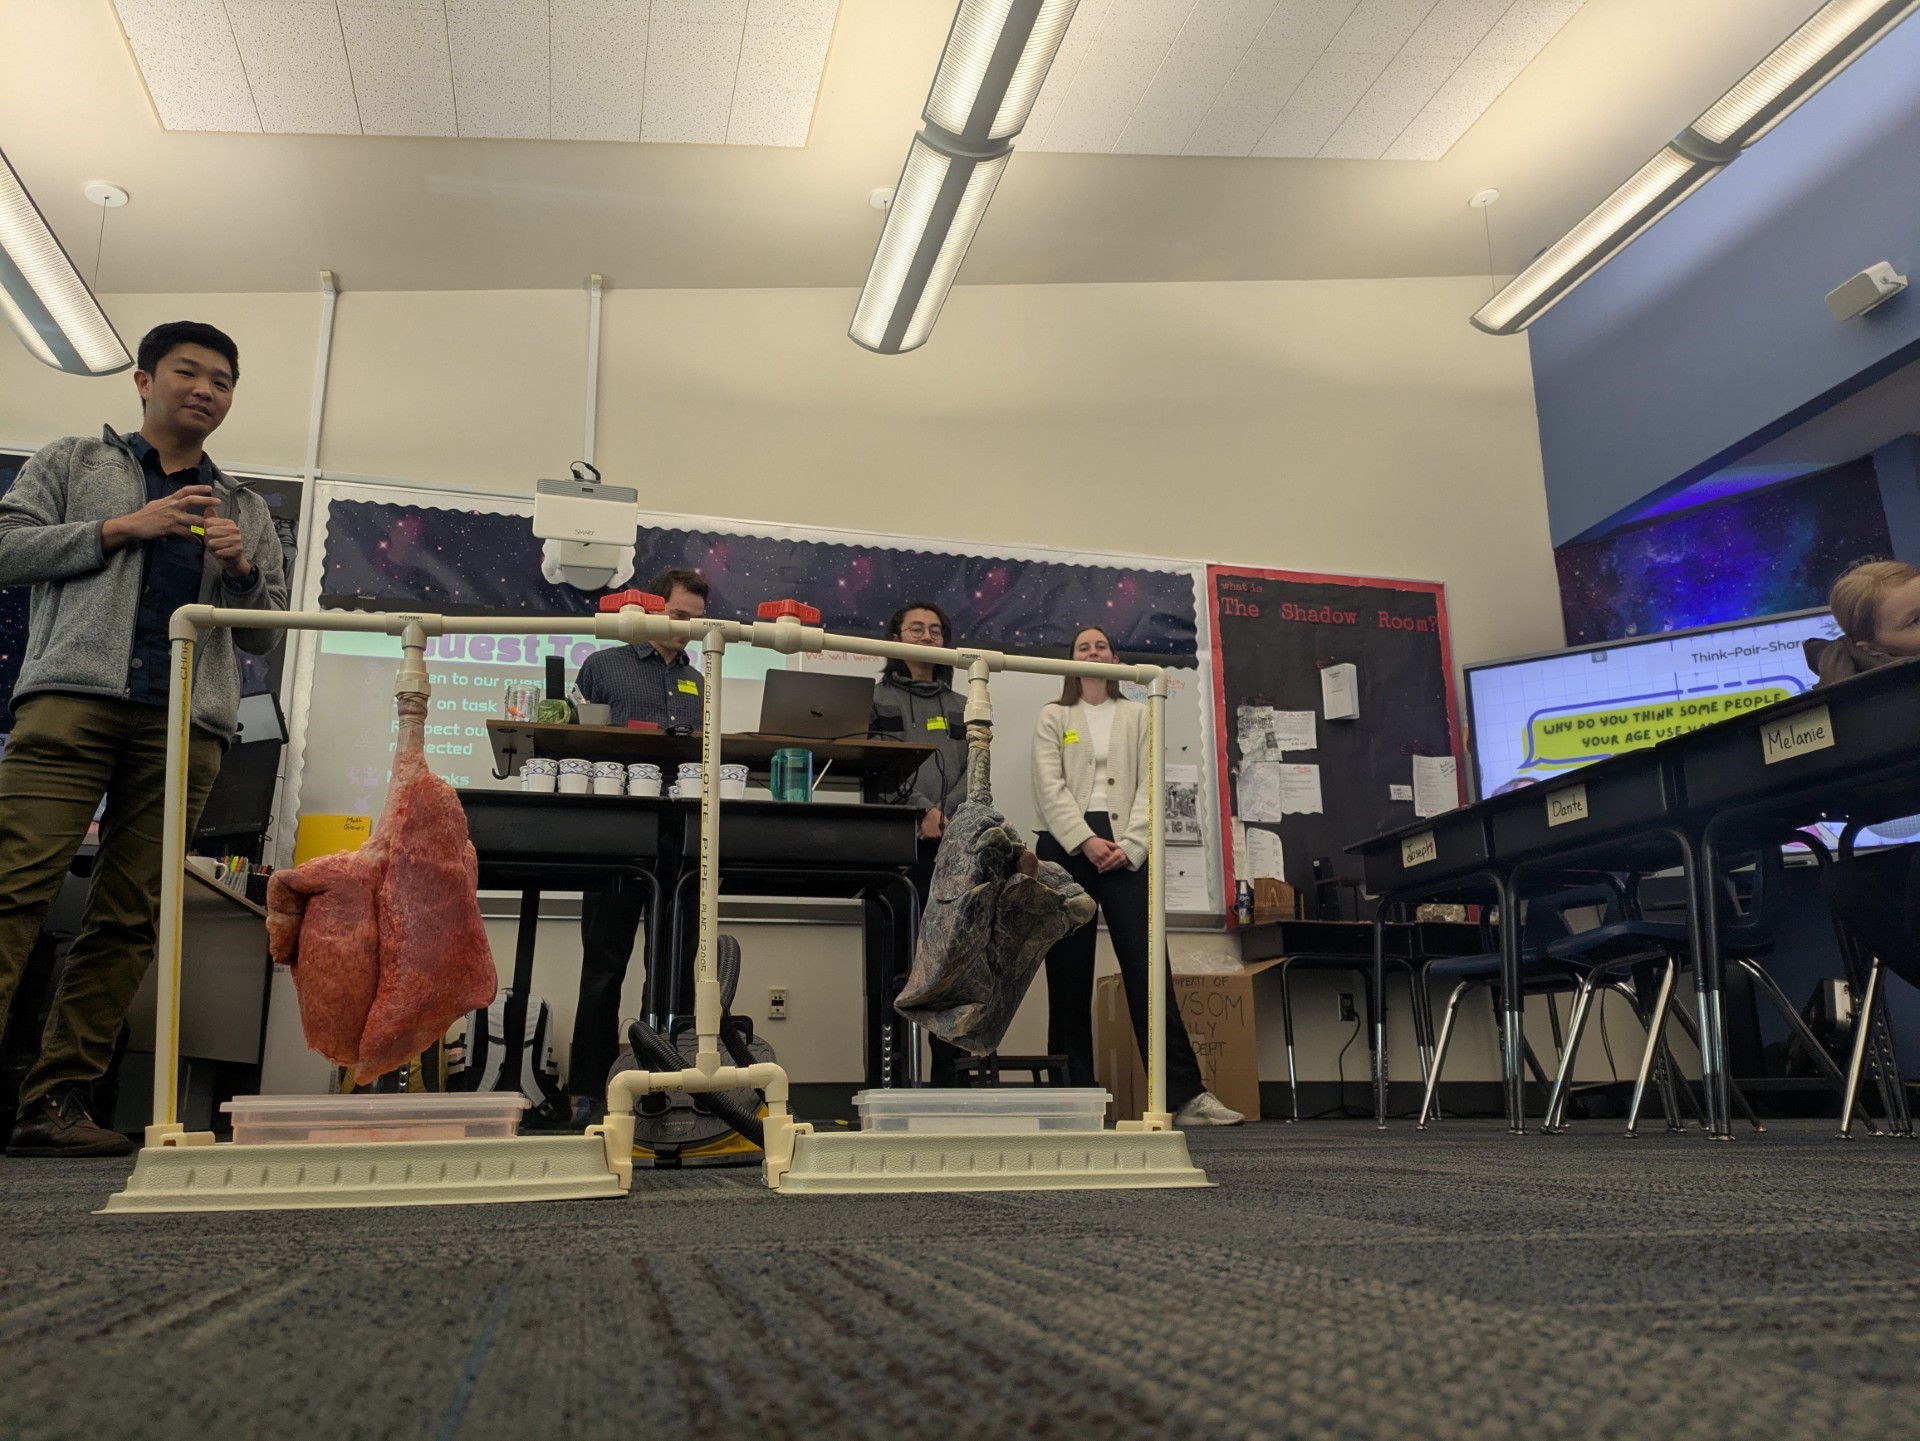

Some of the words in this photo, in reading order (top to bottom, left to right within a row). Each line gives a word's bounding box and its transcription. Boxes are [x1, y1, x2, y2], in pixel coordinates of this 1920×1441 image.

[1221, 582, 1248, 591] what
[1221, 597, 1260, 617] The
[1281, 603, 1358, 625] Shadow
[1377, 611, 1438, 632] Room?
[423, 634, 539, 664] uest
[452, 672, 469, 686] to
[473, 676, 500, 687] our
[436, 699, 457, 711] on
[461, 698, 498, 713] task
[1543, 721, 1573, 736] WHY
[1577, 718, 1595, 730] DO
[1600, 714, 1628, 727] YOU
[1633, 706, 1673, 722] THINK
[1680, 701, 1718, 718] SOME
[1724, 693, 1781, 712] PEOPLE
[391, 719, 461, 736] Rpect
[1582, 734, 1620, 748] YOUR
[1625, 730, 1651, 744] AGE
[1767, 724, 1825, 755] Melanie
[702, 709, 711, 824] CHARLOTTE
[1552, 794, 1583, 818] Dante
[1406, 840, 1434, 863] Joseph
[1213, 976, 1230, 987] OF
